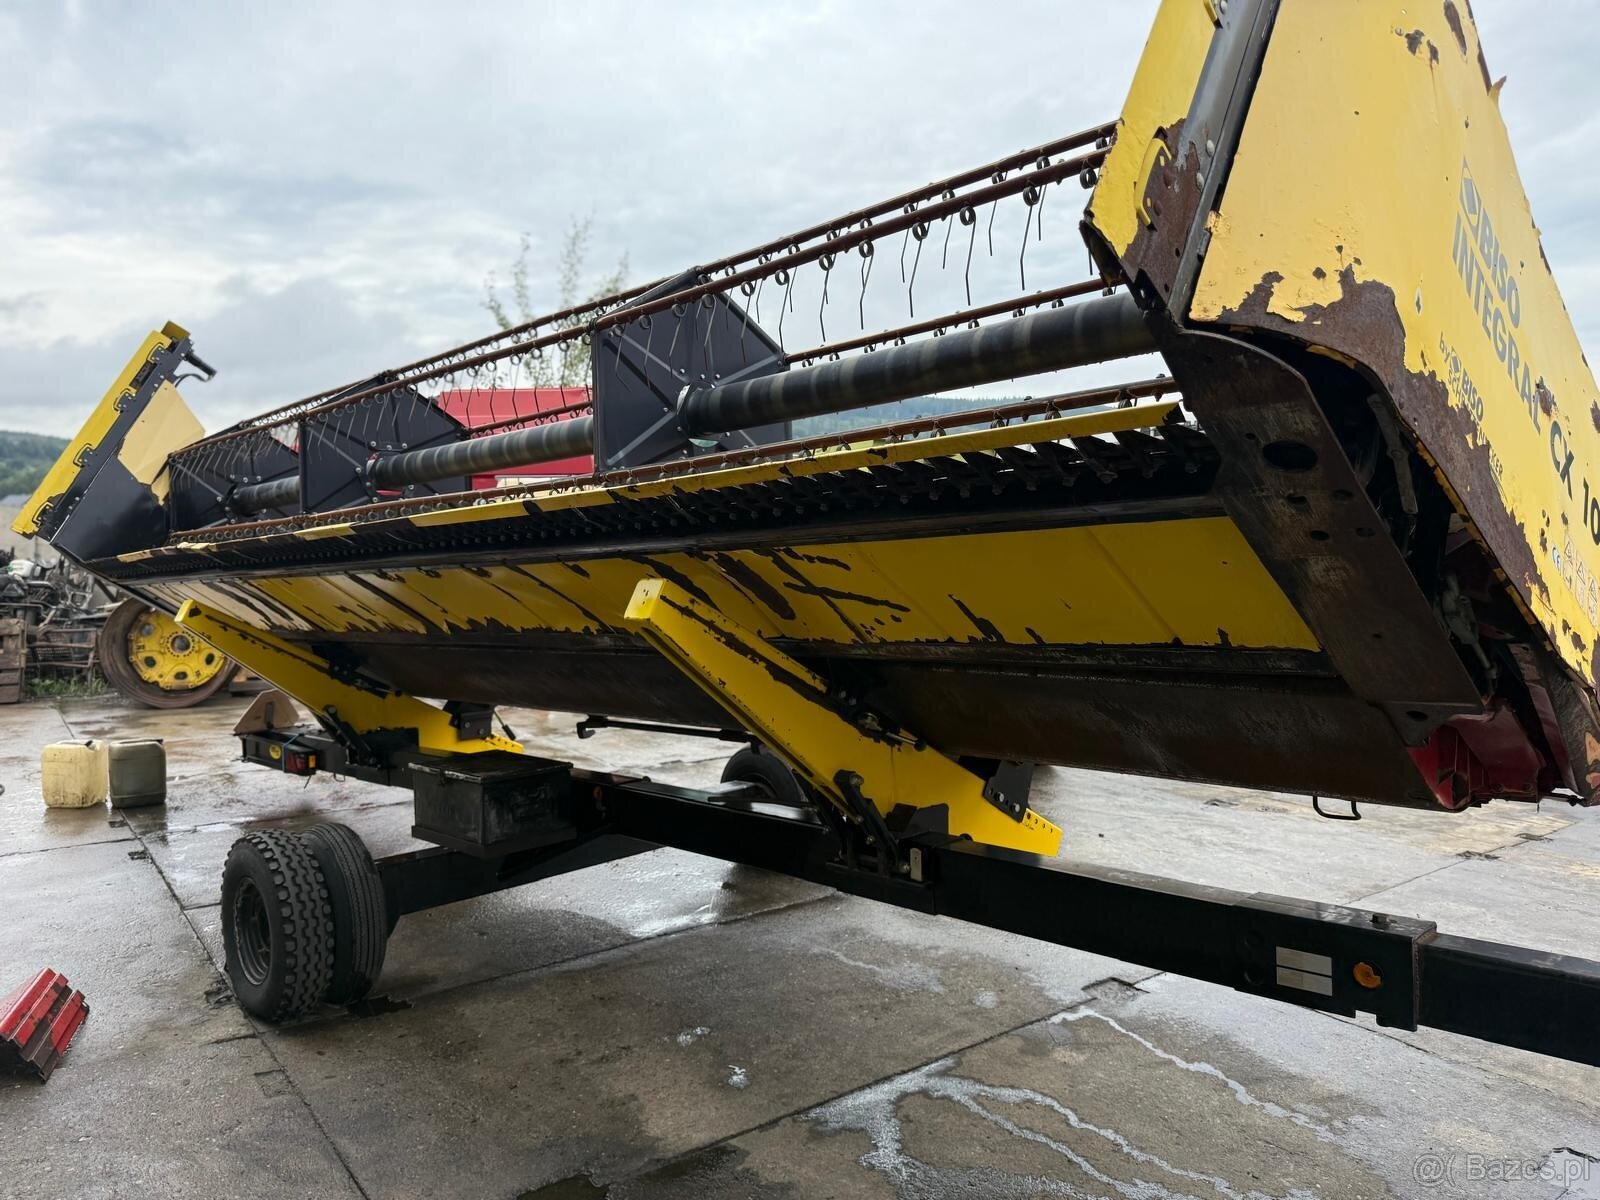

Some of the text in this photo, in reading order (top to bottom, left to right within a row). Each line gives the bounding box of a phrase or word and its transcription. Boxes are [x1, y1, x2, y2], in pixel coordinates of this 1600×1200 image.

[1479, 208, 1520, 328] BISO
[1439, 332, 1483, 422] by BISO
[1452, 211, 1540, 435] INTEGRAL
[1550, 421, 1574, 500] CX
